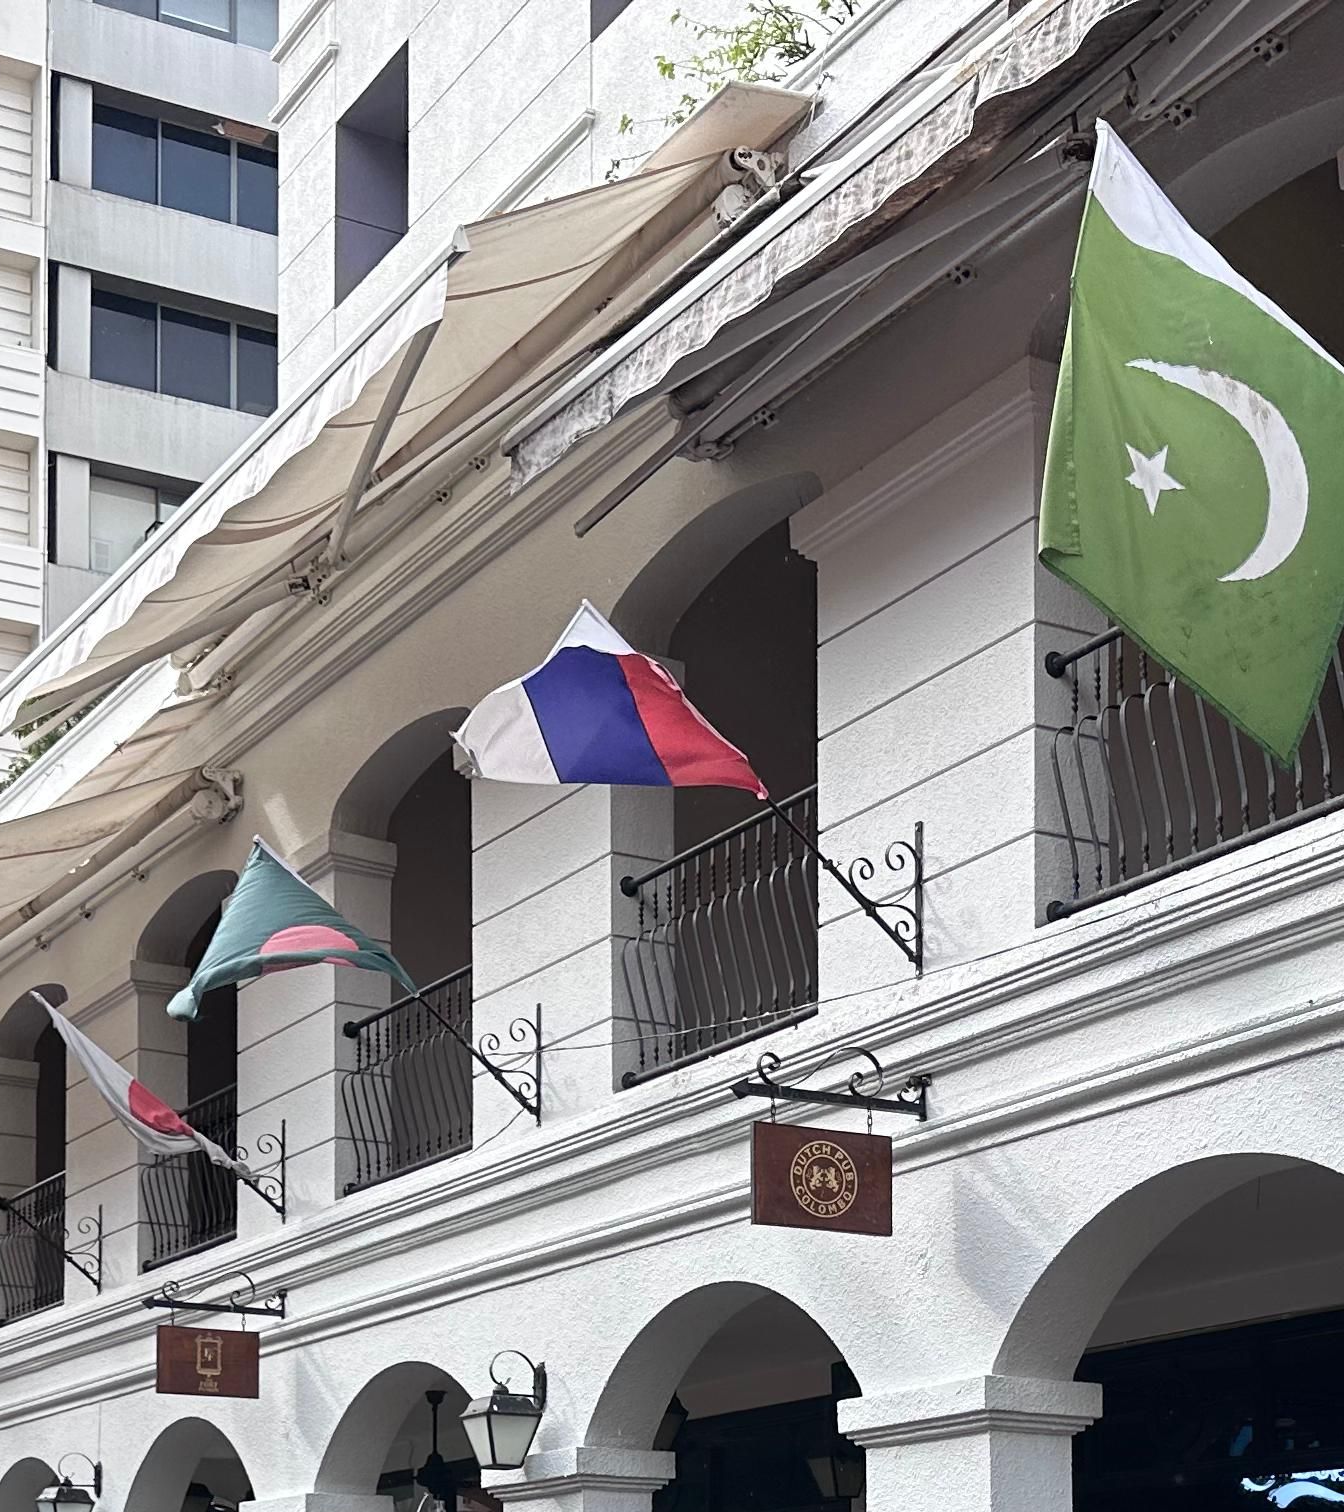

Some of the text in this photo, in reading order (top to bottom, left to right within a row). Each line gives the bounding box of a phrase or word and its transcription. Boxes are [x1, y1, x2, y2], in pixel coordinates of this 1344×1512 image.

[793, 1144, 854, 1181] DUTCH PUB
[795, 1185, 852, 1215] COLOMBO
